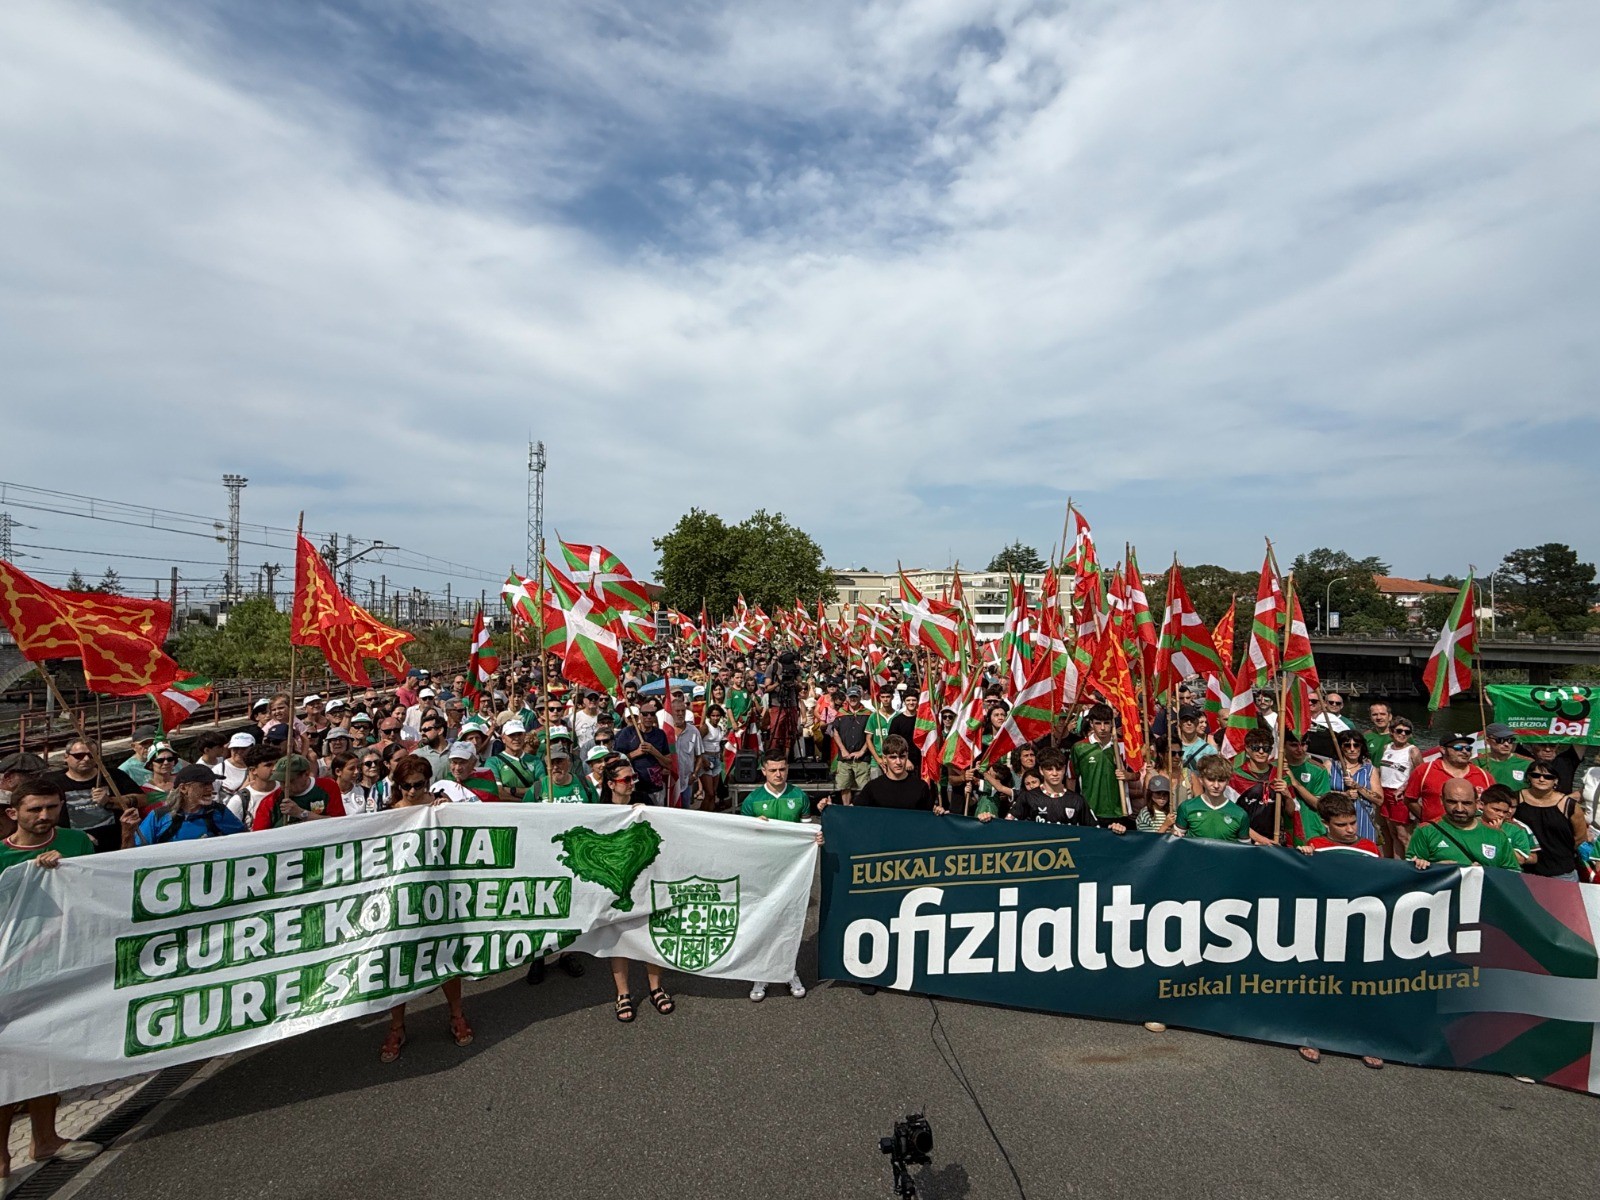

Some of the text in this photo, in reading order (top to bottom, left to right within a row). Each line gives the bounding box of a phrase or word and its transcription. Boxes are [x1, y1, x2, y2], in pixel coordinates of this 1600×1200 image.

[1548, 717, 1591, 736] bai
[139, 828, 496, 916] GURE HERRIA
[852, 847, 1076, 885] EUSKAL SELEKZIOA
[138, 880, 562, 978] GURE KOLOREAK
[842, 866, 1485, 991] ofizialtasuna!
[135, 932, 562, 1047] GURE SELEKZIOA
[1158, 966, 1481, 999] Euskal Herritik mundura!
